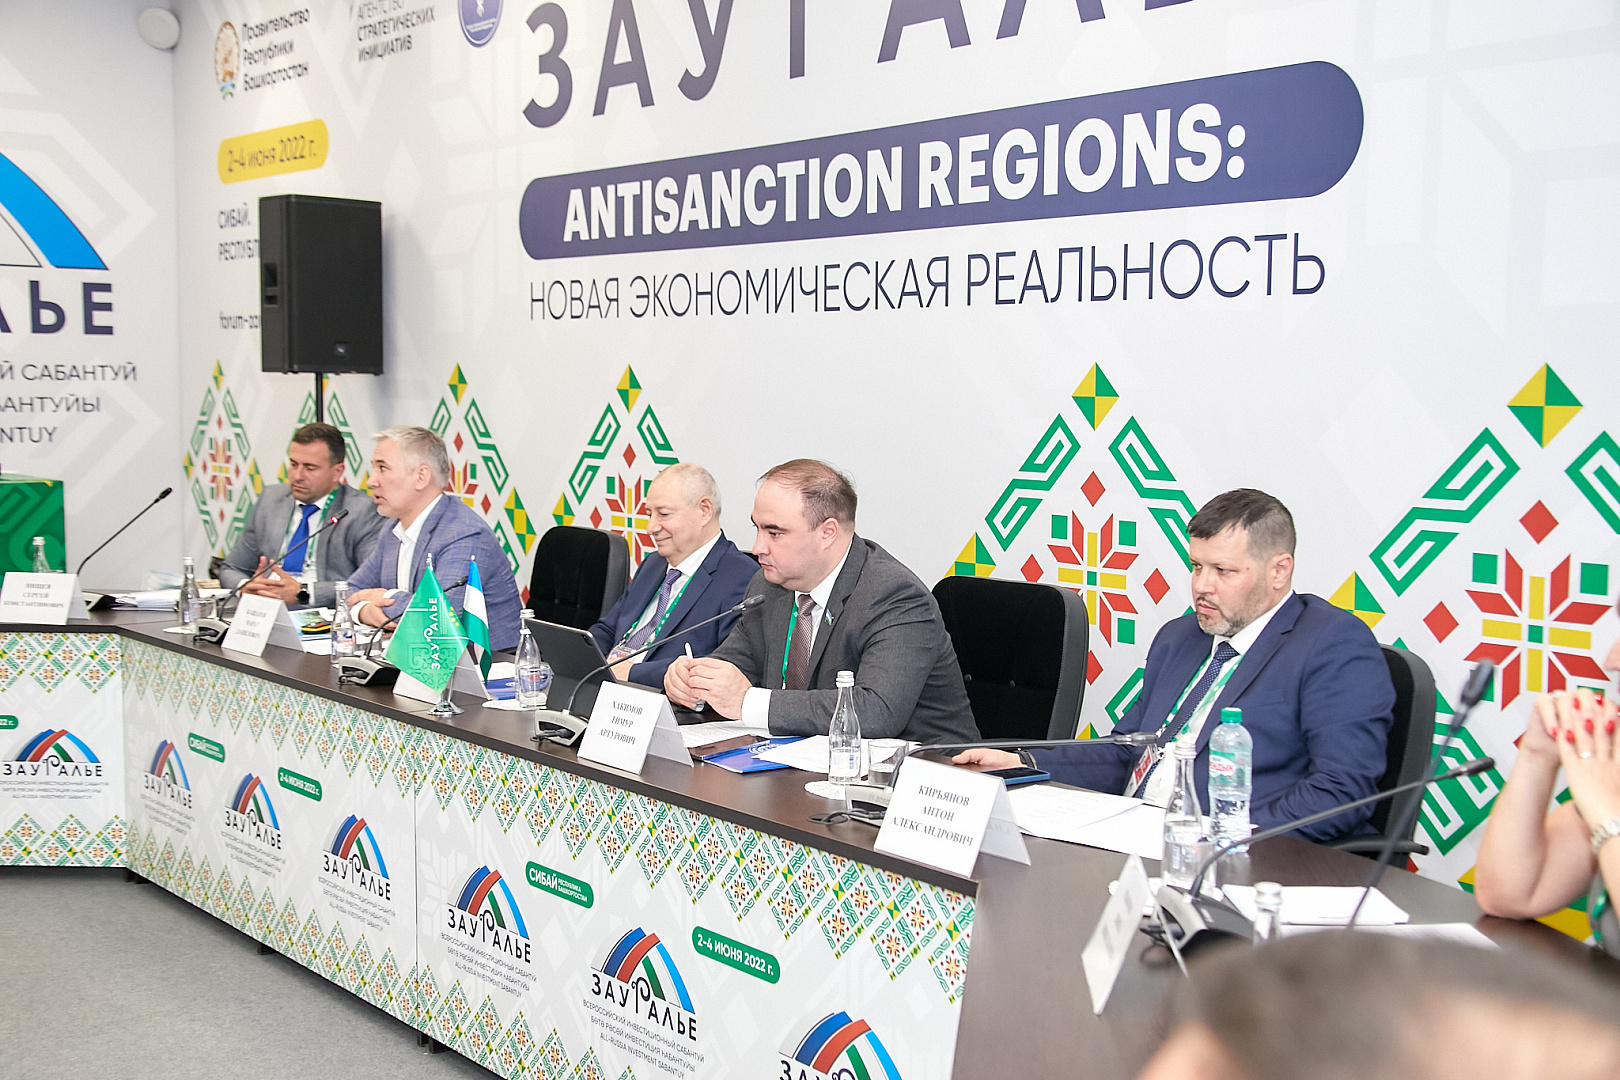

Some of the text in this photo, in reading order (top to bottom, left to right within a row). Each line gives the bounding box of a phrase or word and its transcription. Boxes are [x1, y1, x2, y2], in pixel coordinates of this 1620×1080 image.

[242, 8, 310, 44] Правительство
[358, 6, 435, 41] СТРАТЕГИЧЕСКИХ
[243, 39, 294, 66] Республики
[358, 35, 412, 62] ИНИЦИАТИВ
[243, 62, 309, 91] Башкортостан
[279, 134, 305, 162] 2022
[563, 102, 1246, 242] ANTISANCTION REGIONS:
[530, 232, 1325, 321] НОВАЯ ЭКОНОМИЧЕСКАЯ РЕАЛЬНОСТЬ
[0, 280, 114, 335] ЬЕ
[21, 361, 138, 382] САБАНТУЙ
[0, 393, 101, 413] АНТУЙЫ
[424, 597, 441, 670] ЗАУРАЛЬЕ
[611, 700, 643, 716] ХАКИМОВ
[611, 715, 634, 728] ТИМУР
[599, 728, 636, 745] АРТУРОВИЧ
[2, 755, 102, 776] ЗАУРАЛЬЕ
[144, 772, 192, 809] ЗАУРАЛЬЕ
[918, 784, 970, 807] КИРЬЯНОВ
[920, 805, 955, 822] АНТОН
[225, 809, 281, 850] ЗАУРАЛЬЕ
[890, 817, 974, 847] АЛЕКСАНДРОВИЧ
[323, 854, 391, 901] ЗАУРАЛЬЕ
[529, 867, 558, 890] СИБАЙ
[448, 909, 531, 964] ЗАУРАЛЬЕ
[697, 933, 774, 976] 2-4 ИЮНЯ 2022 г.
[591, 973, 697, 1041] ЗАУРАЛЬЕ
[582, 999, 705, 1063] ВСЕРОССИЙСКИЙ ИНВЕСТИЦИОННЫЙ САБАНТУЙ
[624, 1031, 660, 1054] ИНВЕСТИЦИЯ
[599, 1032, 685, 1079] ALL-RUSSIA INVESTMENT SABANTUY
